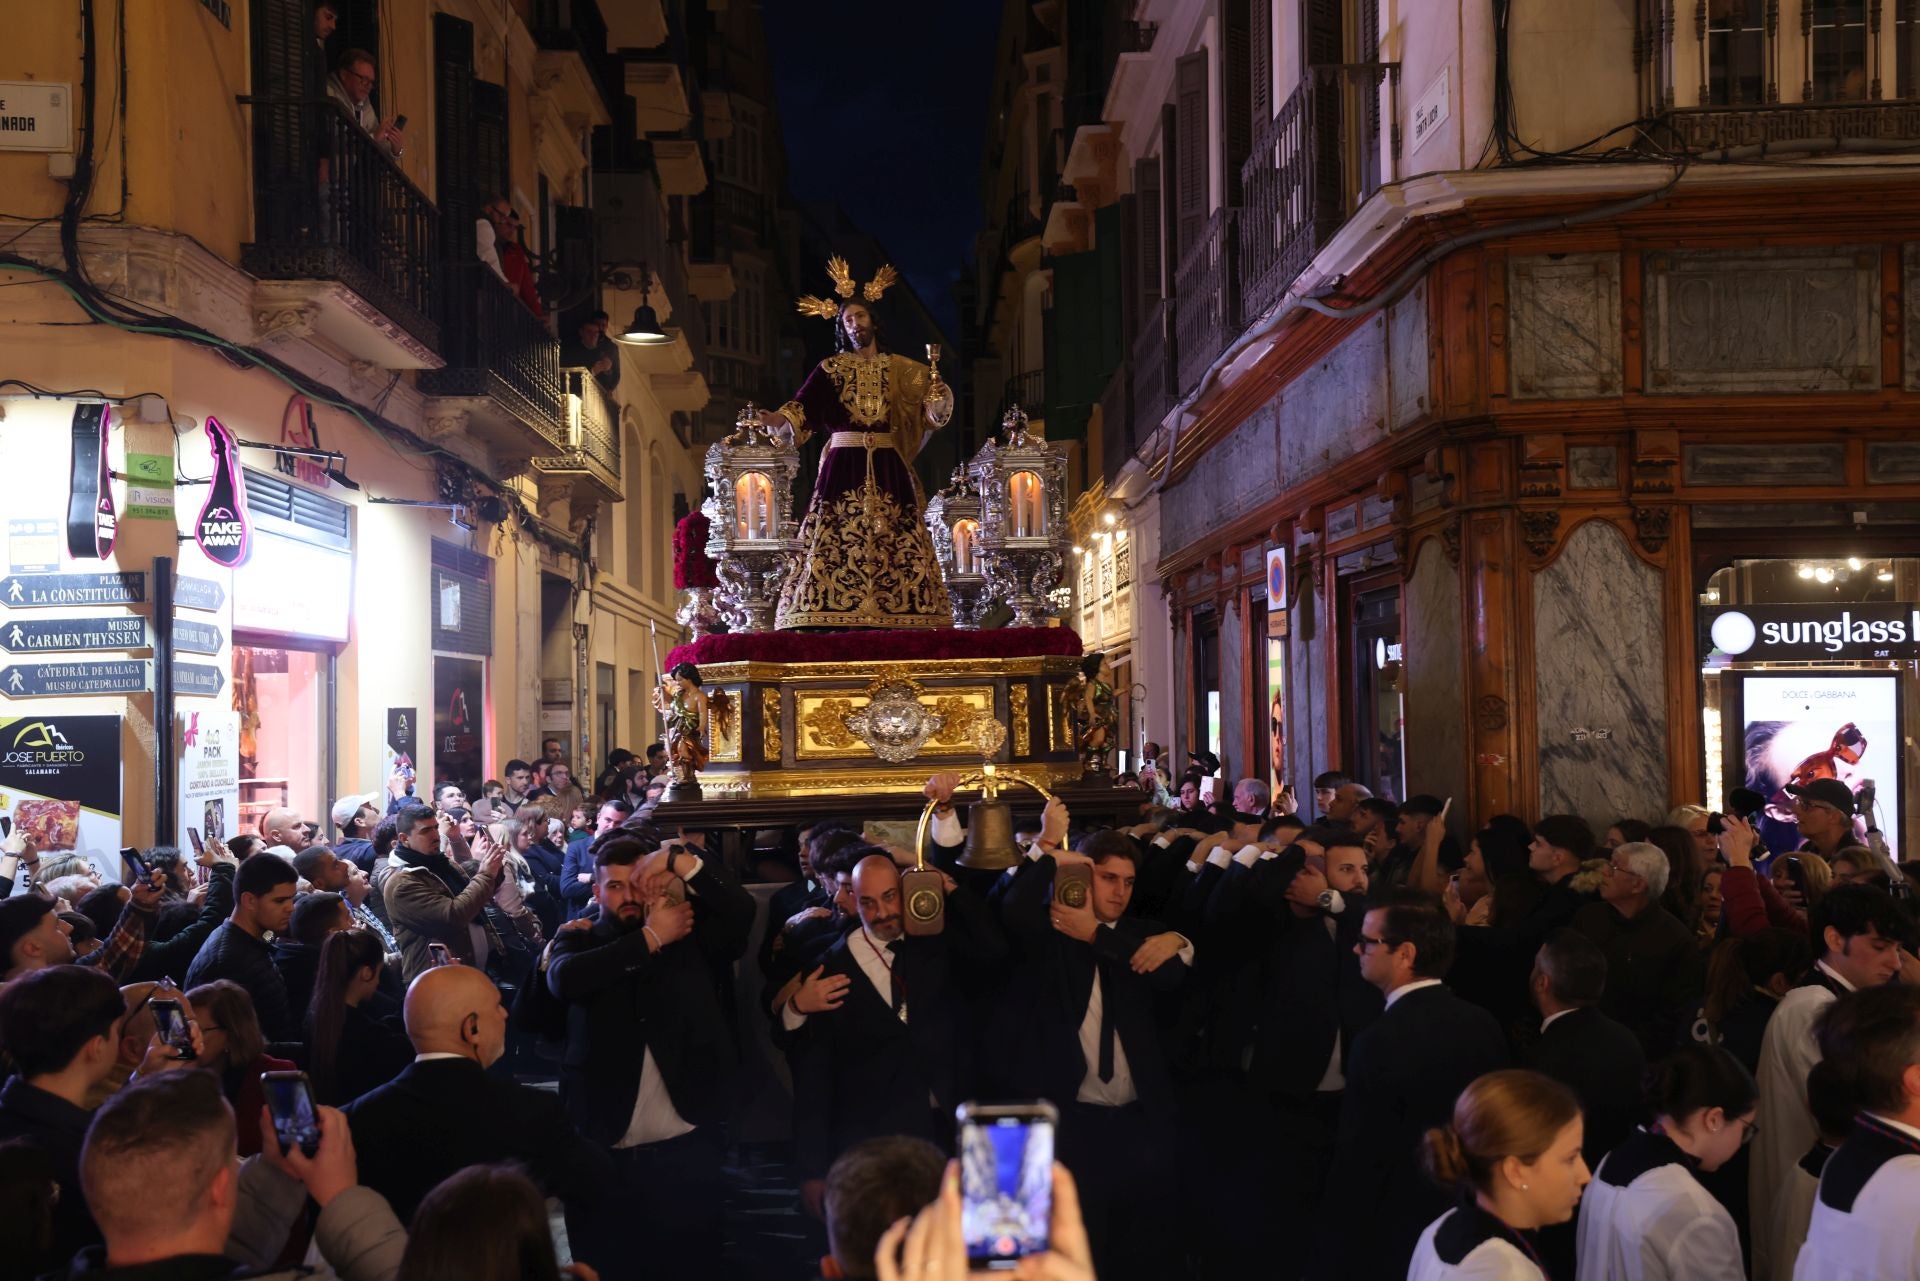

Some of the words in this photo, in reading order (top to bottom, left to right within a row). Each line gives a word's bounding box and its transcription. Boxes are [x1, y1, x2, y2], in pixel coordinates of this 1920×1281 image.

[0, 116, 35, 131] NADA
[202, 522, 242, 534] TAKE
[202, 535, 242, 546] AWAY
[100, 575, 125, 585] PLAZA
[128, 575, 140, 584] DE
[32, 590, 47, 602] LA
[107, 620, 140, 631] MUSEO
[1762, 611, 1906, 652] sunglass
[27, 634, 80, 648] CARMEN
[83, 631, 140, 645] THYSSEN
[37, 666, 88, 678] CATEDRAL
[92, 666, 102, 676] DE
[45, 682, 76, 691] MUSEO
[79, 678, 140, 689] CATEDRALICIO
[1782, 690, 1808, 699] DOLCE
[1815, 690, 1857, 699] GABBANA
[2, 752, 34, 763] JOSE
[36, 750, 84, 762] PUERTO
[204, 746, 221, 758] PACK
